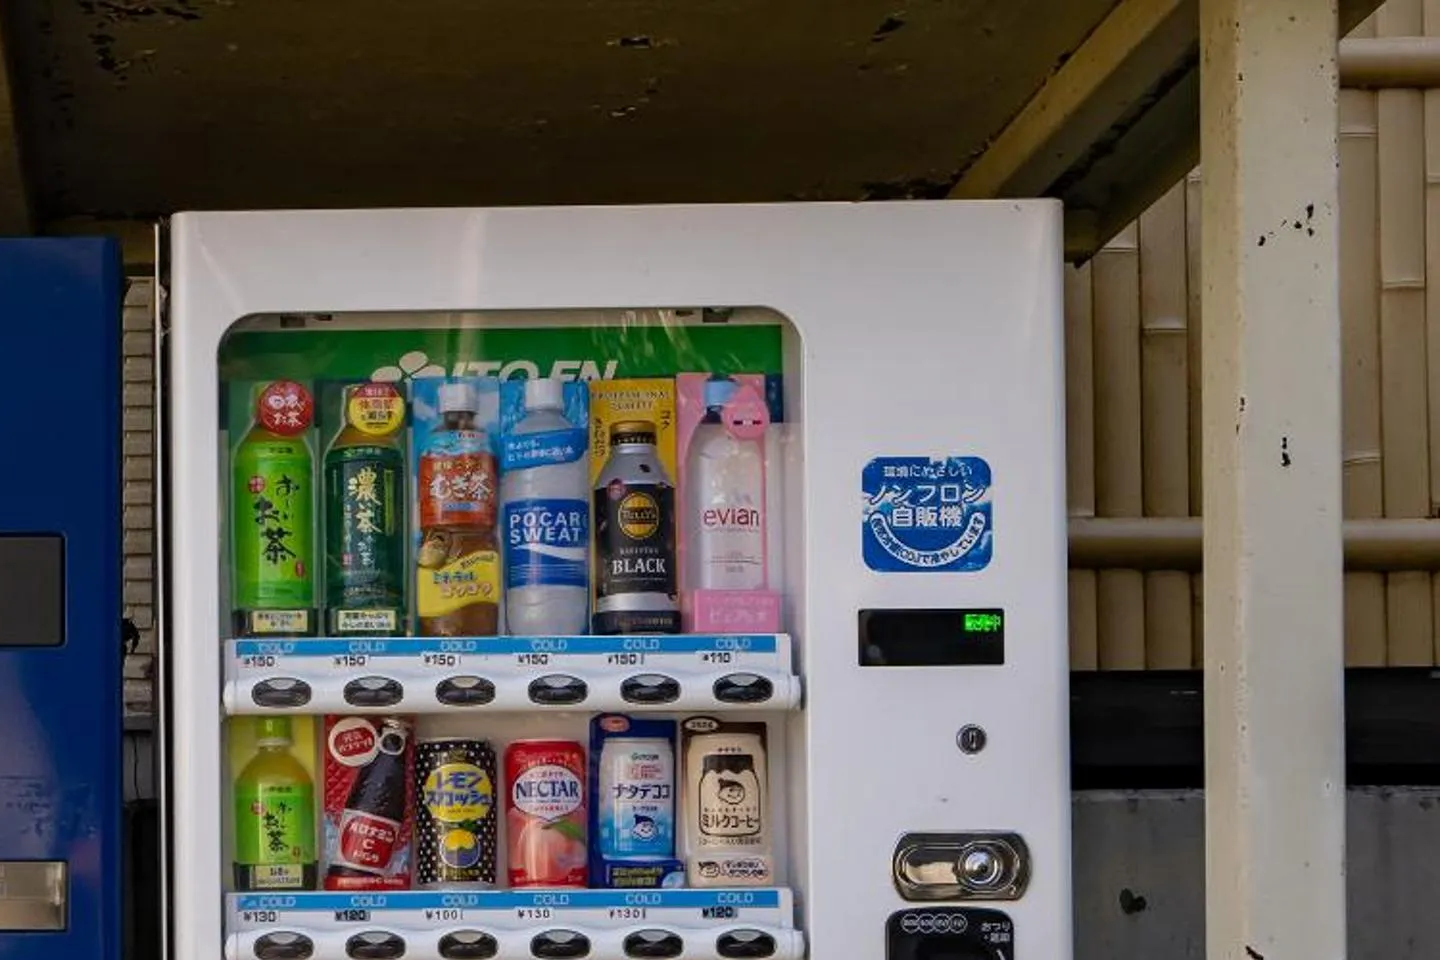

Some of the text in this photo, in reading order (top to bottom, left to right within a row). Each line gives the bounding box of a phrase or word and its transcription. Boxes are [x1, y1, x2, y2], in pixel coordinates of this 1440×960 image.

[450, 359, 620, 381] ITO EN
[430, 472, 492, 499] むぎ茶
[868, 480, 986, 505] ノンフロン
[703, 508, 760, 527] evian
[891, 503, 963, 528] 自販機
[510, 527, 582, 545] SWEAT
[611, 558, 666, 576] BLACK
[258, 642, 295, 653] COLD
[348, 642, 386, 652] COLD
[439, 640, 477, 651] COLD
[531, 640, 568, 651] COLD
[623, 638, 660, 650] COLD
[715, 638, 752, 649] COLD
[424, 654, 456, 666] ¥150
[435, 771, 483, 790] レモン
[516, 780, 581, 799] NECTAR
[612, 784, 671, 800] ナタデココ
[702, 813, 760, 830] ミルクコーヒー
[259, 896, 296, 908] COLD
[351, 896, 387, 907] COLD
[442, 895, 479, 906] COLD
[533, 894, 570, 906] COLD
[625, 892, 662, 905] COLD
[717, 892, 754, 904] COLD
[244, 911, 276, 922] ¥130
[425, 909, 458, 920] ¥100
[517, 909, 550, 919] ¥130
[702, 906, 733, 918] ¥120
[981, 922, 1011, 933] おつり
